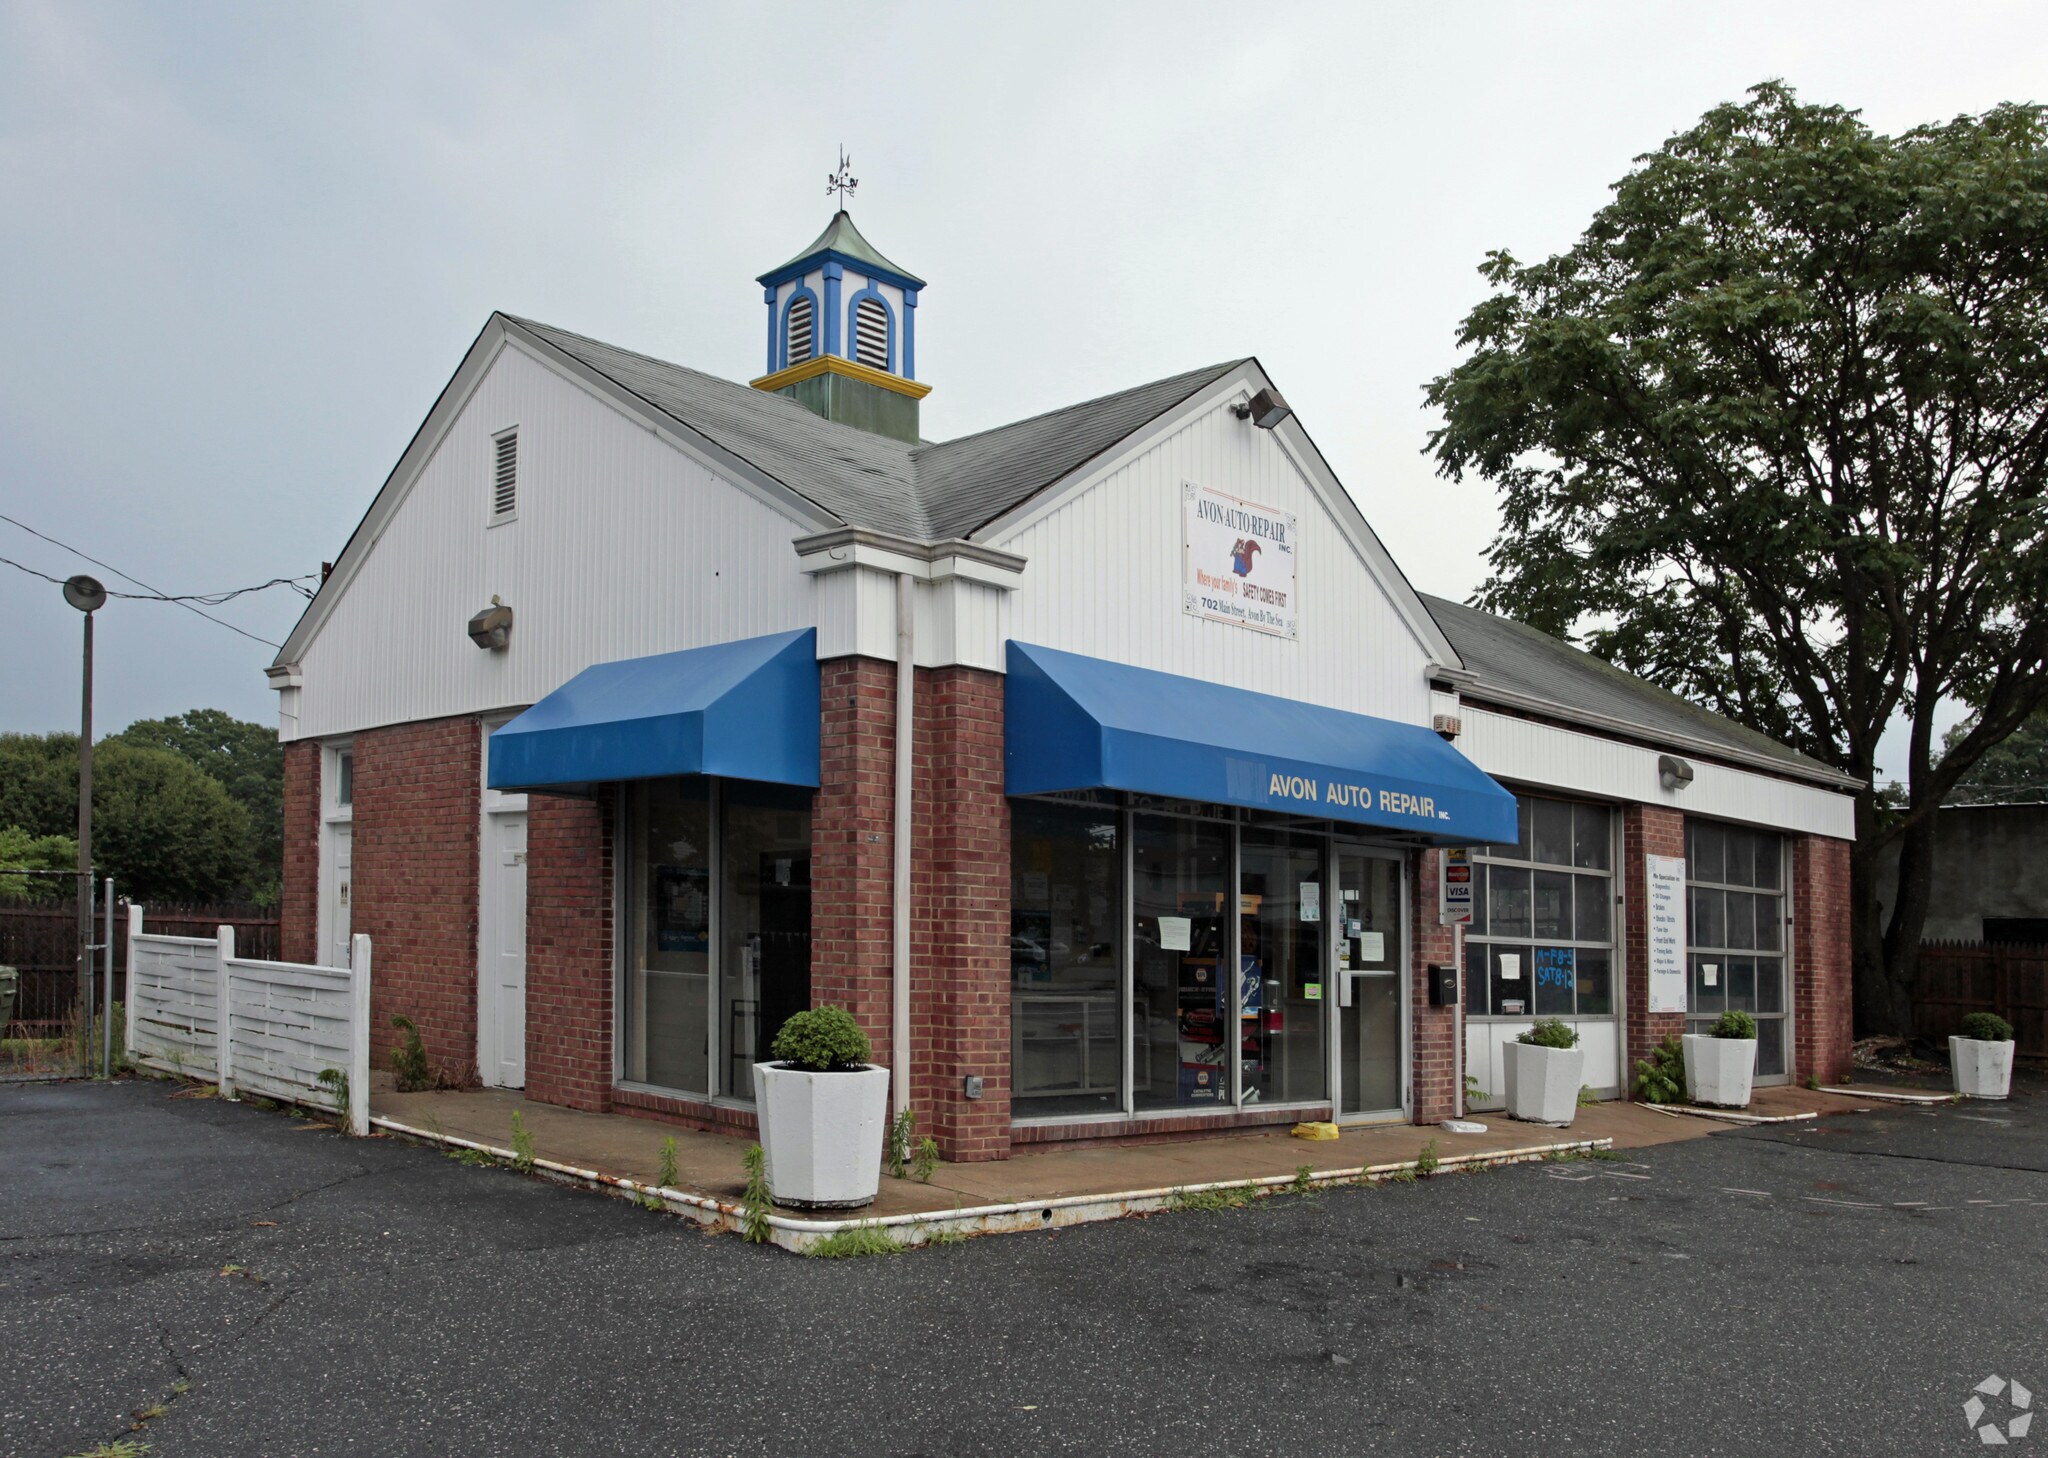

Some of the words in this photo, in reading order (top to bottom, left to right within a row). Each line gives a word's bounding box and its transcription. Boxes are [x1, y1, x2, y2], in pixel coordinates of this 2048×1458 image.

[1197, 499, 1223, 525] AVON
[1225, 508, 1250, 533] AUTO
[1251, 515, 1285, 543] REPAIR
[1278, 543, 1292, 555] INC.
[1242, 582, 1259, 600] SAFETY
[1259, 587, 1275, 605] COMES
[1275, 591, 1287, 608] FIRST
[1201, 597, 1218, 610] 702
[1218, 600, 1231, 615] Main
[1248, 607, 1259, 621] Avon
[1266, 611, 1275, 624] The
[1275, 613, 1284, 627] Sea
[1269, 773, 1317, 801] AVON
[1326, 782, 1372, 809] AUTO
[1379, 790, 1435, 818] REPAIR
[1438, 810, 1451, 820] INC.
[1449, 887, 1469, 896] VISA
